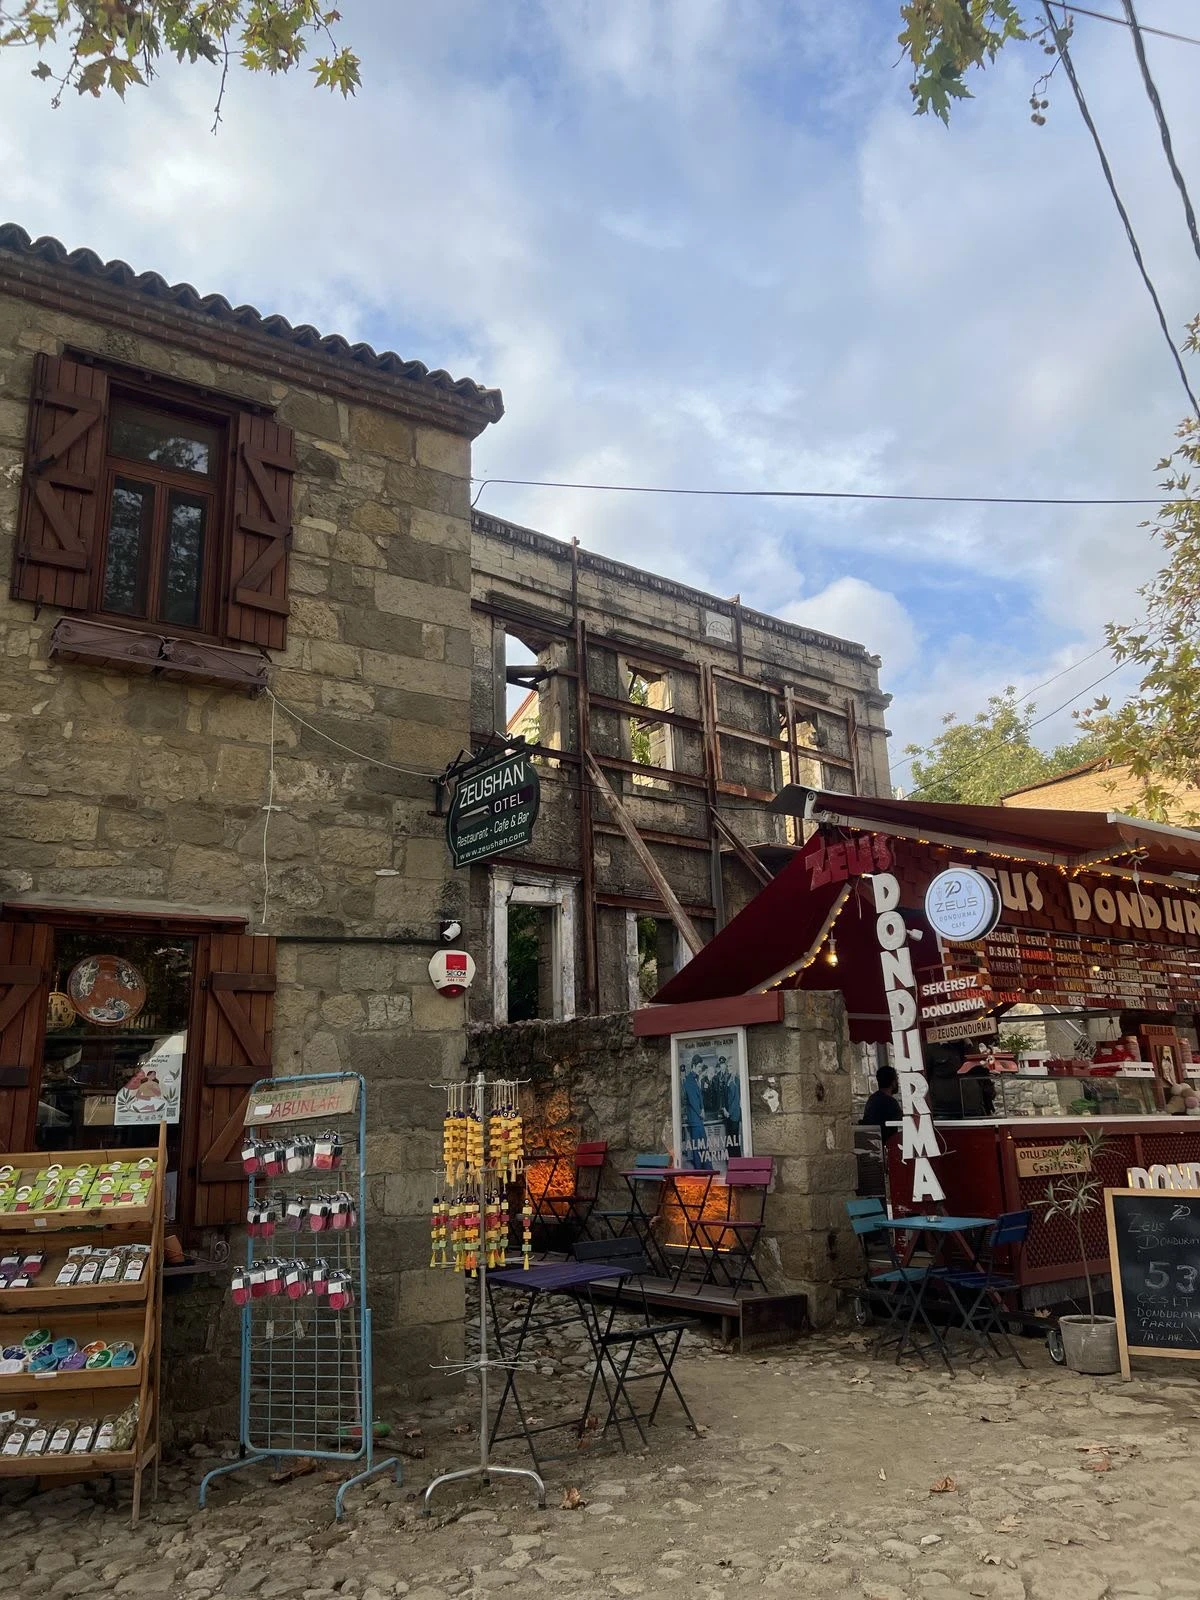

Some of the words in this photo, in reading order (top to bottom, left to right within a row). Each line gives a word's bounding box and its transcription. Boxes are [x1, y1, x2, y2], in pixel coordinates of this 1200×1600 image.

[459, 761, 524, 809] ZEUSHAN
[494, 793, 524, 813] OTEL
[457, 827, 489, 848] Restaurant
[494, 818, 510, 834] Cafe
[510, 814, 516, 828] &
[517, 811, 529, 824] Bar
[460, 831, 525, 860] www.zeushan.com
[805, 835, 892, 891] ZEUS
[935, 897, 977, 913] ZEUS
[938, 911, 977, 922] DONDURMA
[921, 997, 985, 1019] DONDURMA
[1068, 995, 1085, 1005] OREO
[871, 872, 946, 1202] DONDURMA
[937, 1020, 992, 1039] ZEUSDONDURMA
[685, 1134, 741, 1151] ALMANYALI
[1020, 1150, 1040, 1160] OTLU
[1144, 1261, 1199, 1293] 53
